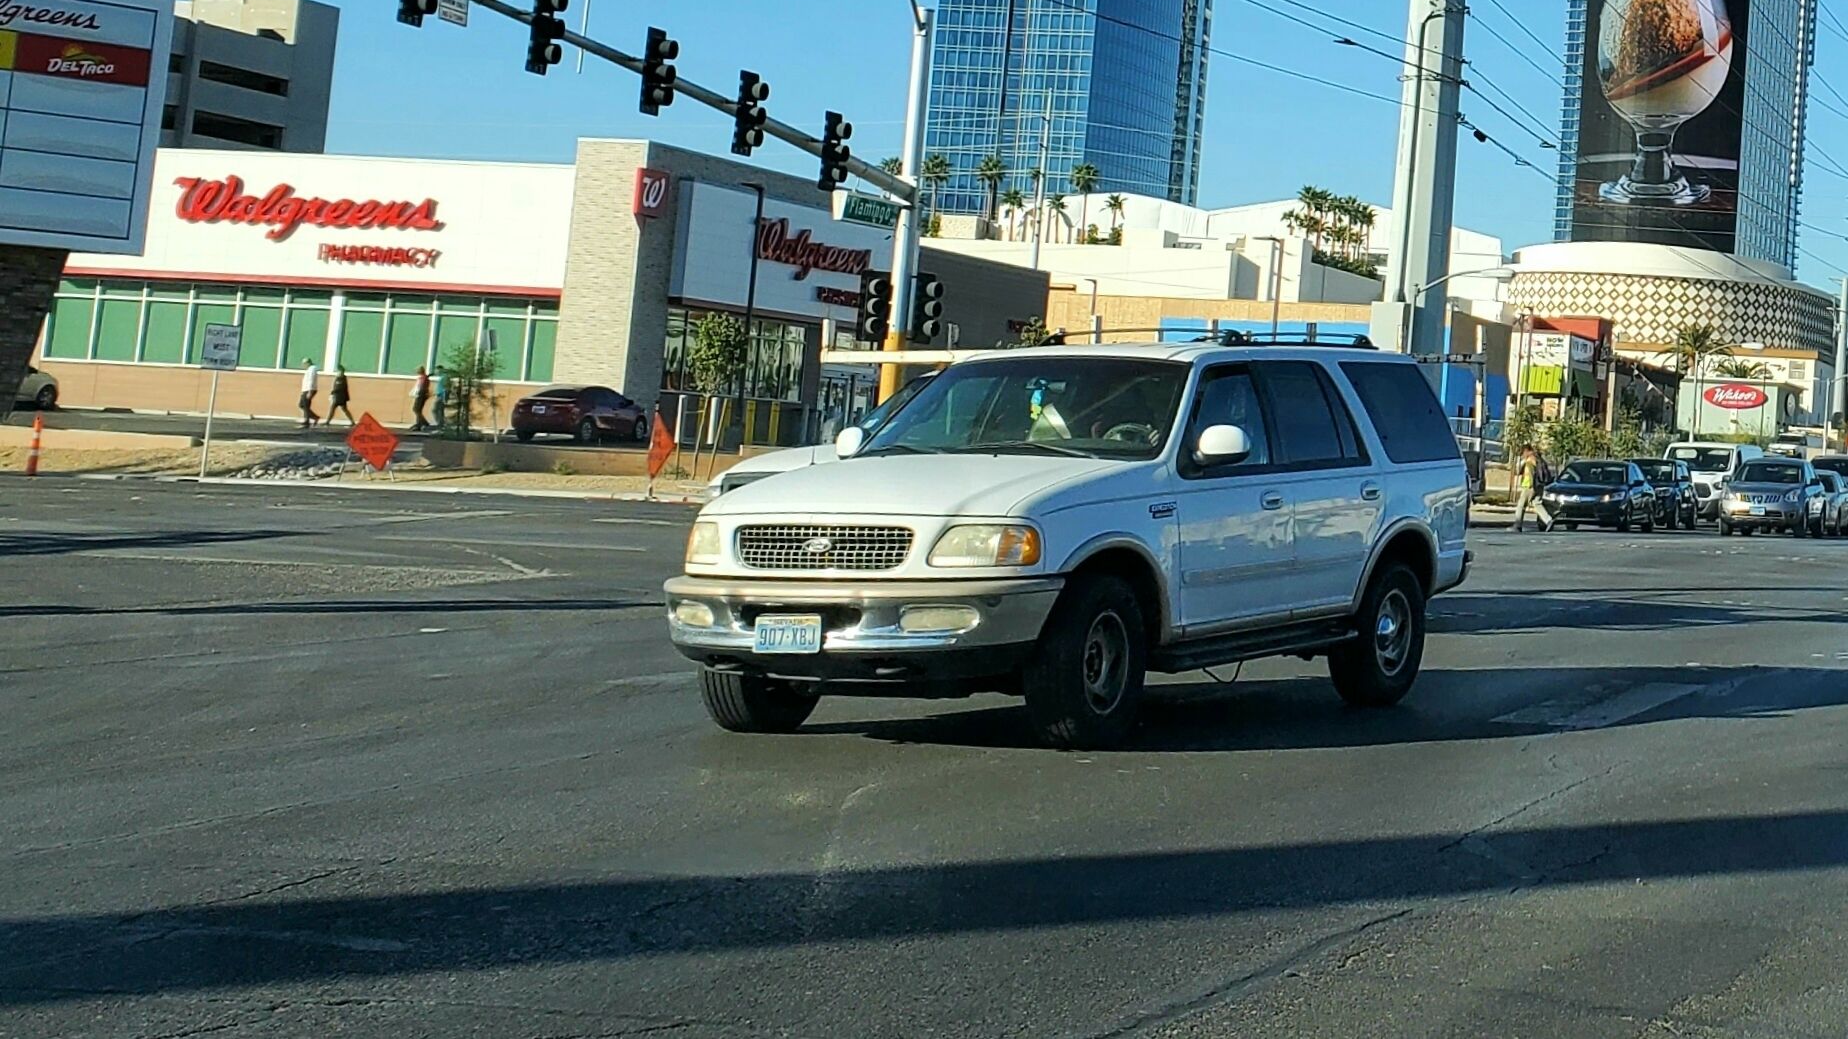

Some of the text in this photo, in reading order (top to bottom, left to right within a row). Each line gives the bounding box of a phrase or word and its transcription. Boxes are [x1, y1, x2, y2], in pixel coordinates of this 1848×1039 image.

[642, 176, 666, 208] W
[173, 174, 445, 242] Walgreens
[850, 198, 892, 224] Flamingo
[317, 243, 441, 269] PHARMACY
